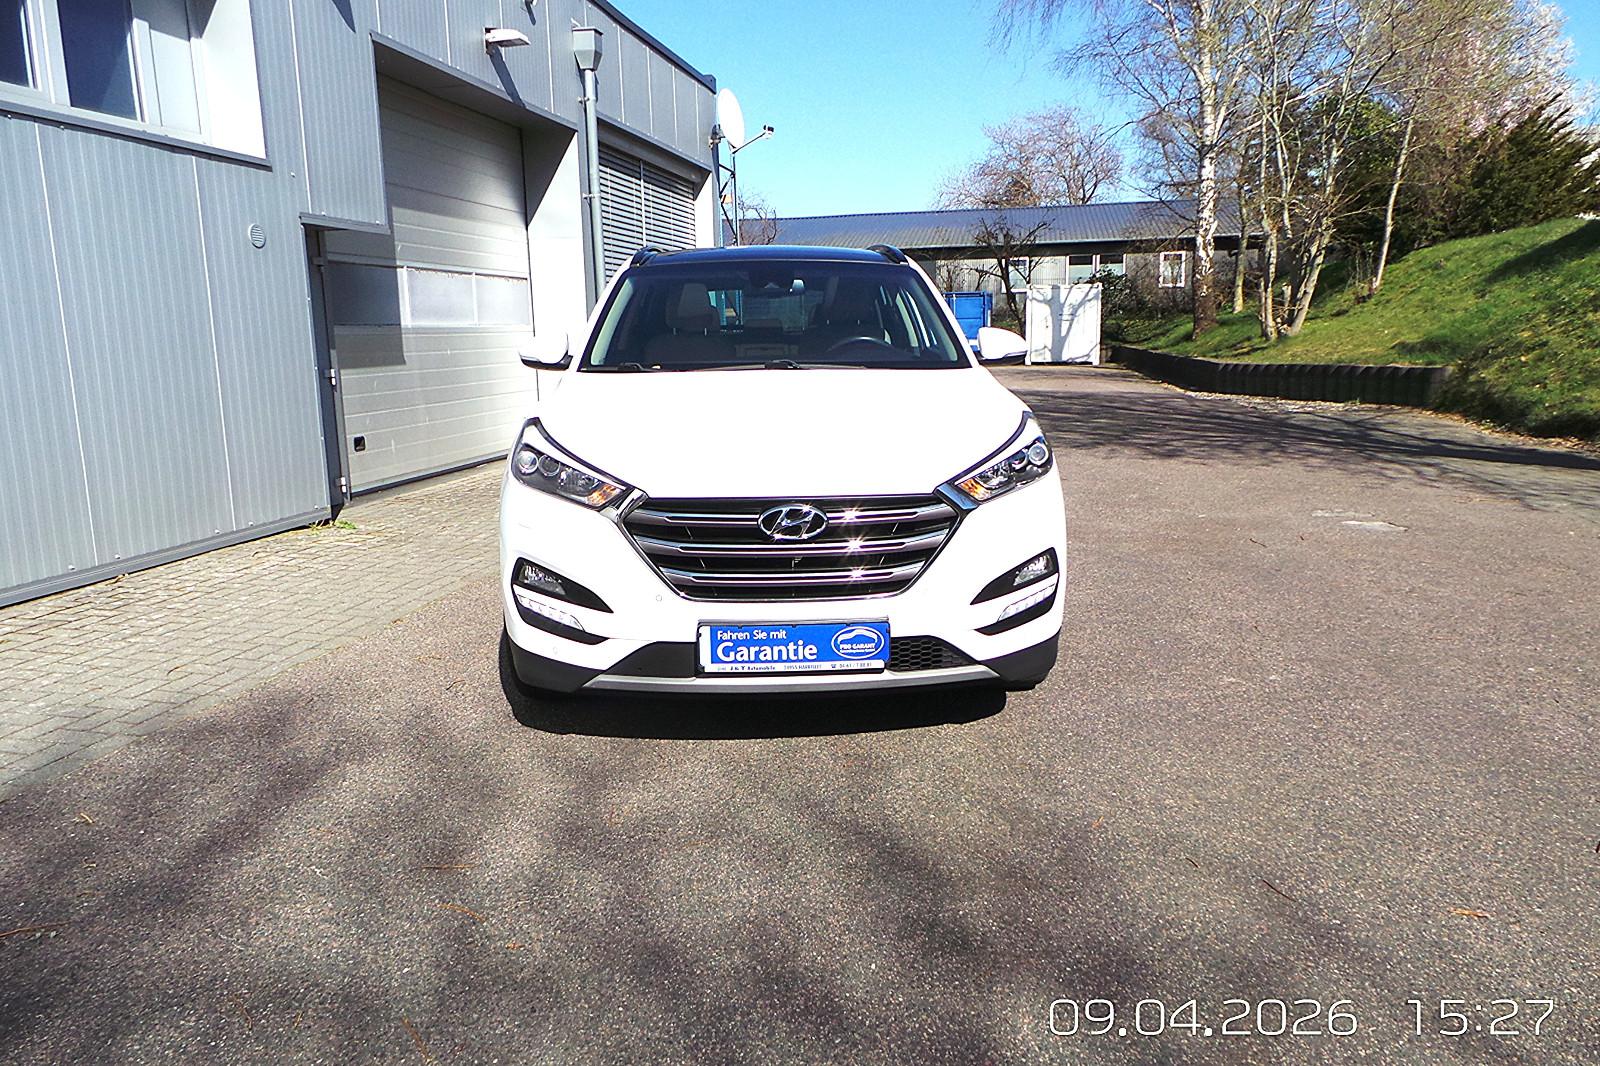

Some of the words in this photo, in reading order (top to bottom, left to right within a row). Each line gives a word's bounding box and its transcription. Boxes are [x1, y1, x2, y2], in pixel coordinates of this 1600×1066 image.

[717, 630, 750, 641] Fahren
[753, 630, 768, 640] Sie
[770, 629, 787, 639] mit
[716, 639, 818, 662] Garantie
